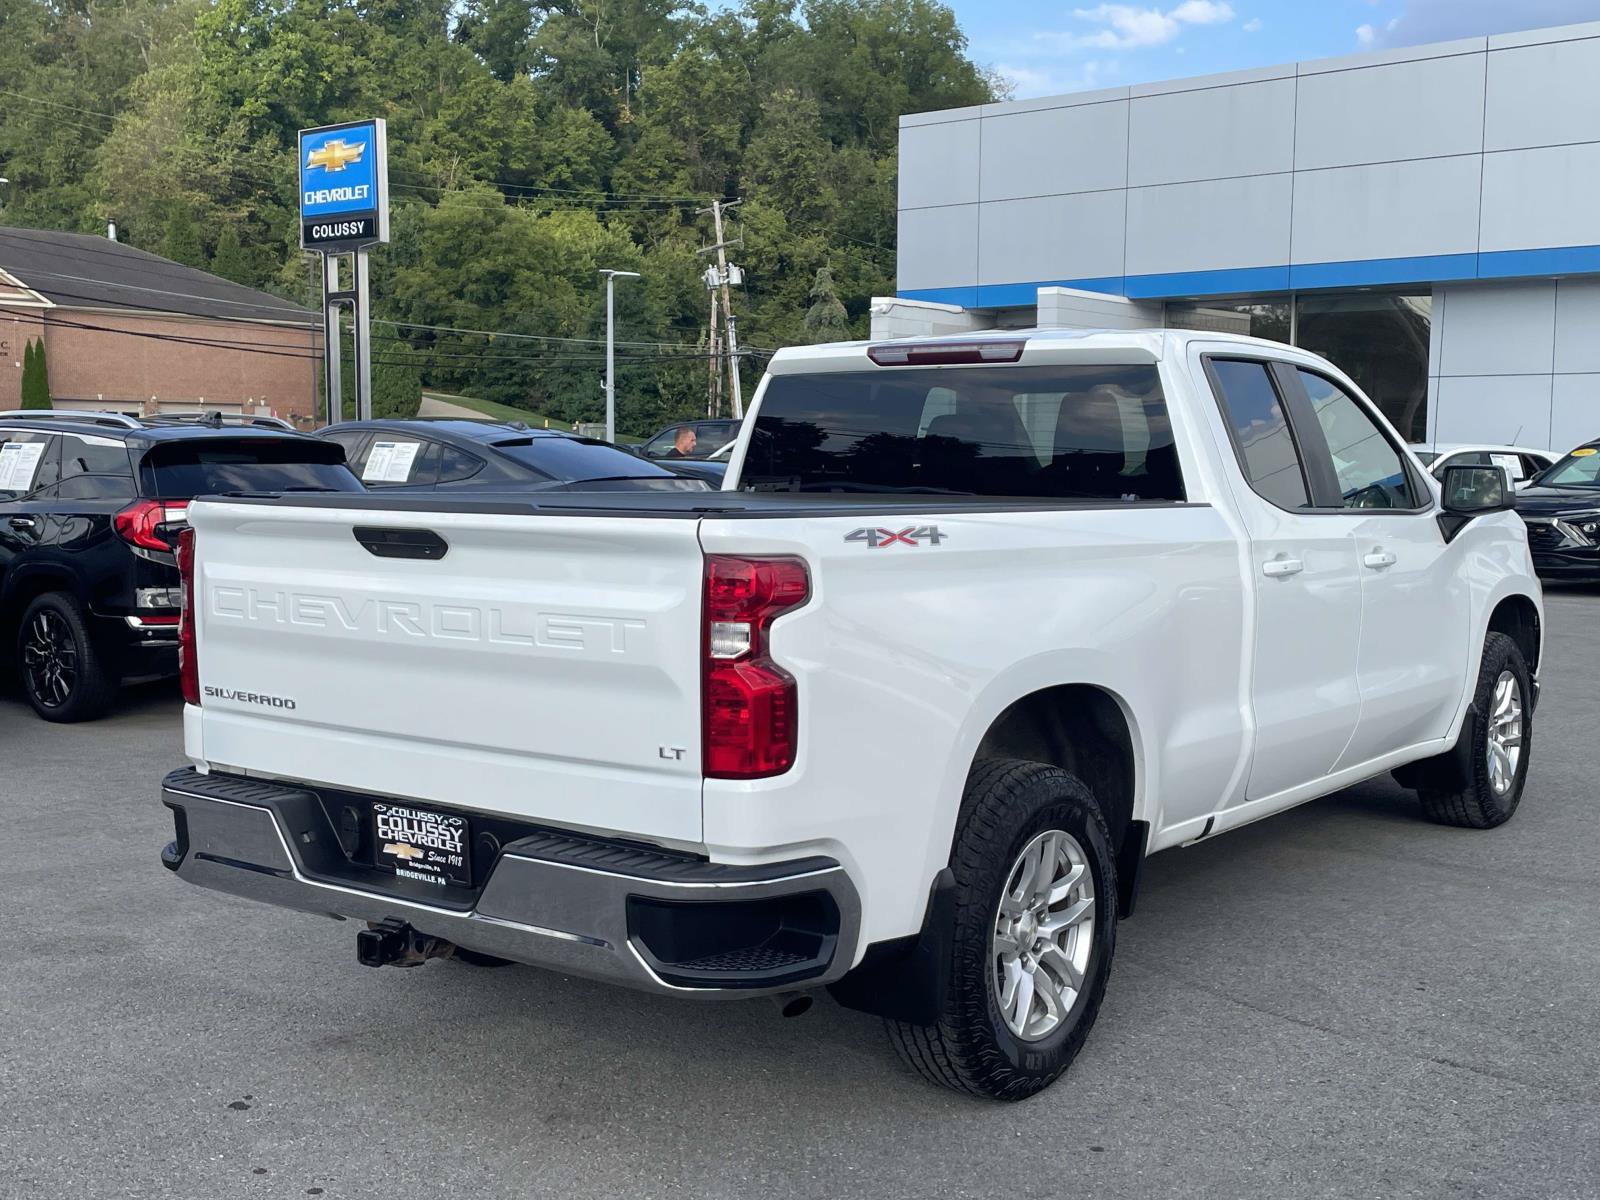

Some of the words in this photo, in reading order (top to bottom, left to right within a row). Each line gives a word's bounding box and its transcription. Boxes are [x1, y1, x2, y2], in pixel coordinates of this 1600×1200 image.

[304, 184, 369, 205] CHEVROLET
[312, 221, 365, 238] COLUSSY
[211, 586, 646, 654] CHEVROLET
[204, 686, 296, 710] SILVERADO
[659, 746, 687, 760] LT
[391, 807, 443, 824] COLUSSY
[377, 814, 463, 842] COLUSSY
[378, 828, 463, 853] CHEVROLET
[427, 851, 446, 864] Since
[447, 854, 463, 867] 1918
[437, 877, 446, 885] PA
